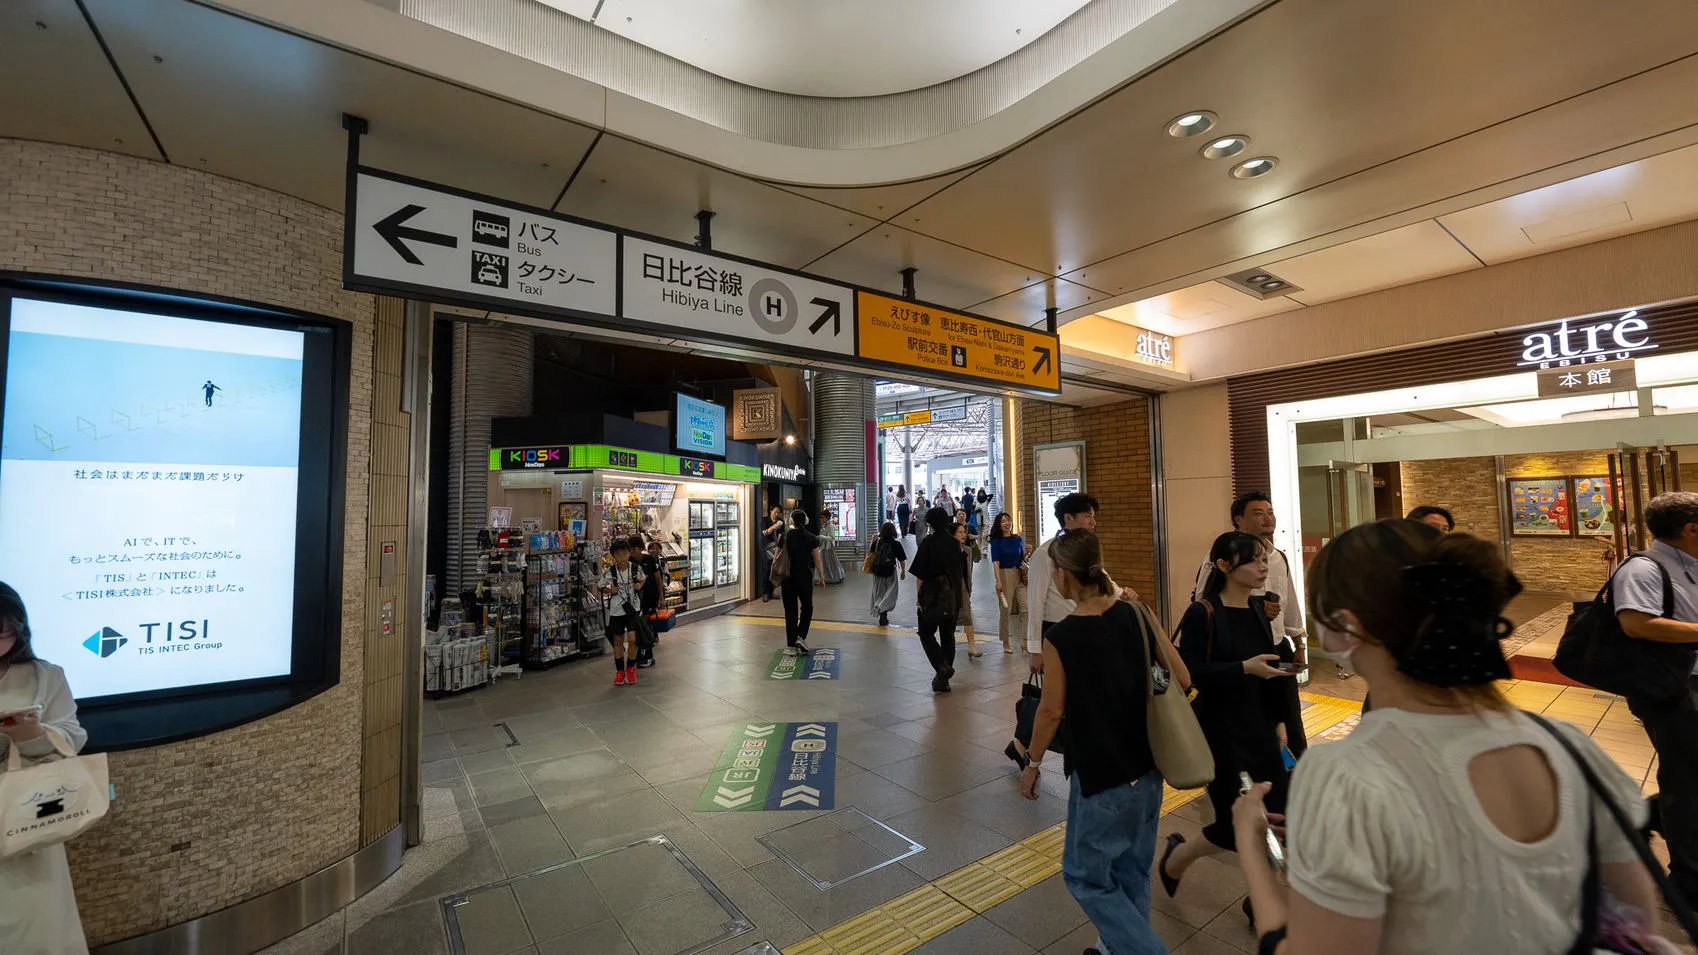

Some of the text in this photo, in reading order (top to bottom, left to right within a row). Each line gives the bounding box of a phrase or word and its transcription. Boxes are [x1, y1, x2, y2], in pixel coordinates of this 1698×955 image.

[518, 221, 559, 246] バス
[517, 242, 542, 257] Bus
[474, 252, 506, 267] TAXI
[517, 261, 595, 286] タクシー
[642, 253, 743, 297] 日比谷線
[517, 282, 543, 297] Taxi
[662, 288, 744, 316] Hibiya Line
[766, 296, 782, 317] H
[890, 305, 931, 326] えびす像
[902, 323, 931, 337] Sculpture
[1522, 310, 1649, 362] atré
[907, 336, 948, 357] 駅前交番
[1137, 331, 1171, 361] atré
[917, 353, 949, 366] Police Box
[994, 353, 1026, 371] 駒沢通り
[1540, 351, 1630, 369] EBISU
[1558, 368, 1612, 388] 本館
[511, 449, 560, 462] KIOSK
[685, 460, 710, 472] KIOSK
[763, 464, 797, 481] KINOKUNIYA
[69, 551, 242, 565] もっとスムーズな社会のために。
[139, 620, 208, 643] TISI
[138, 641, 223, 655] TIS INTEC Group
[732, 771, 753, 779] JR
[789, 752, 808, 780] 日比谷線
[6, 809, 91, 836] CINNAMOROLL
